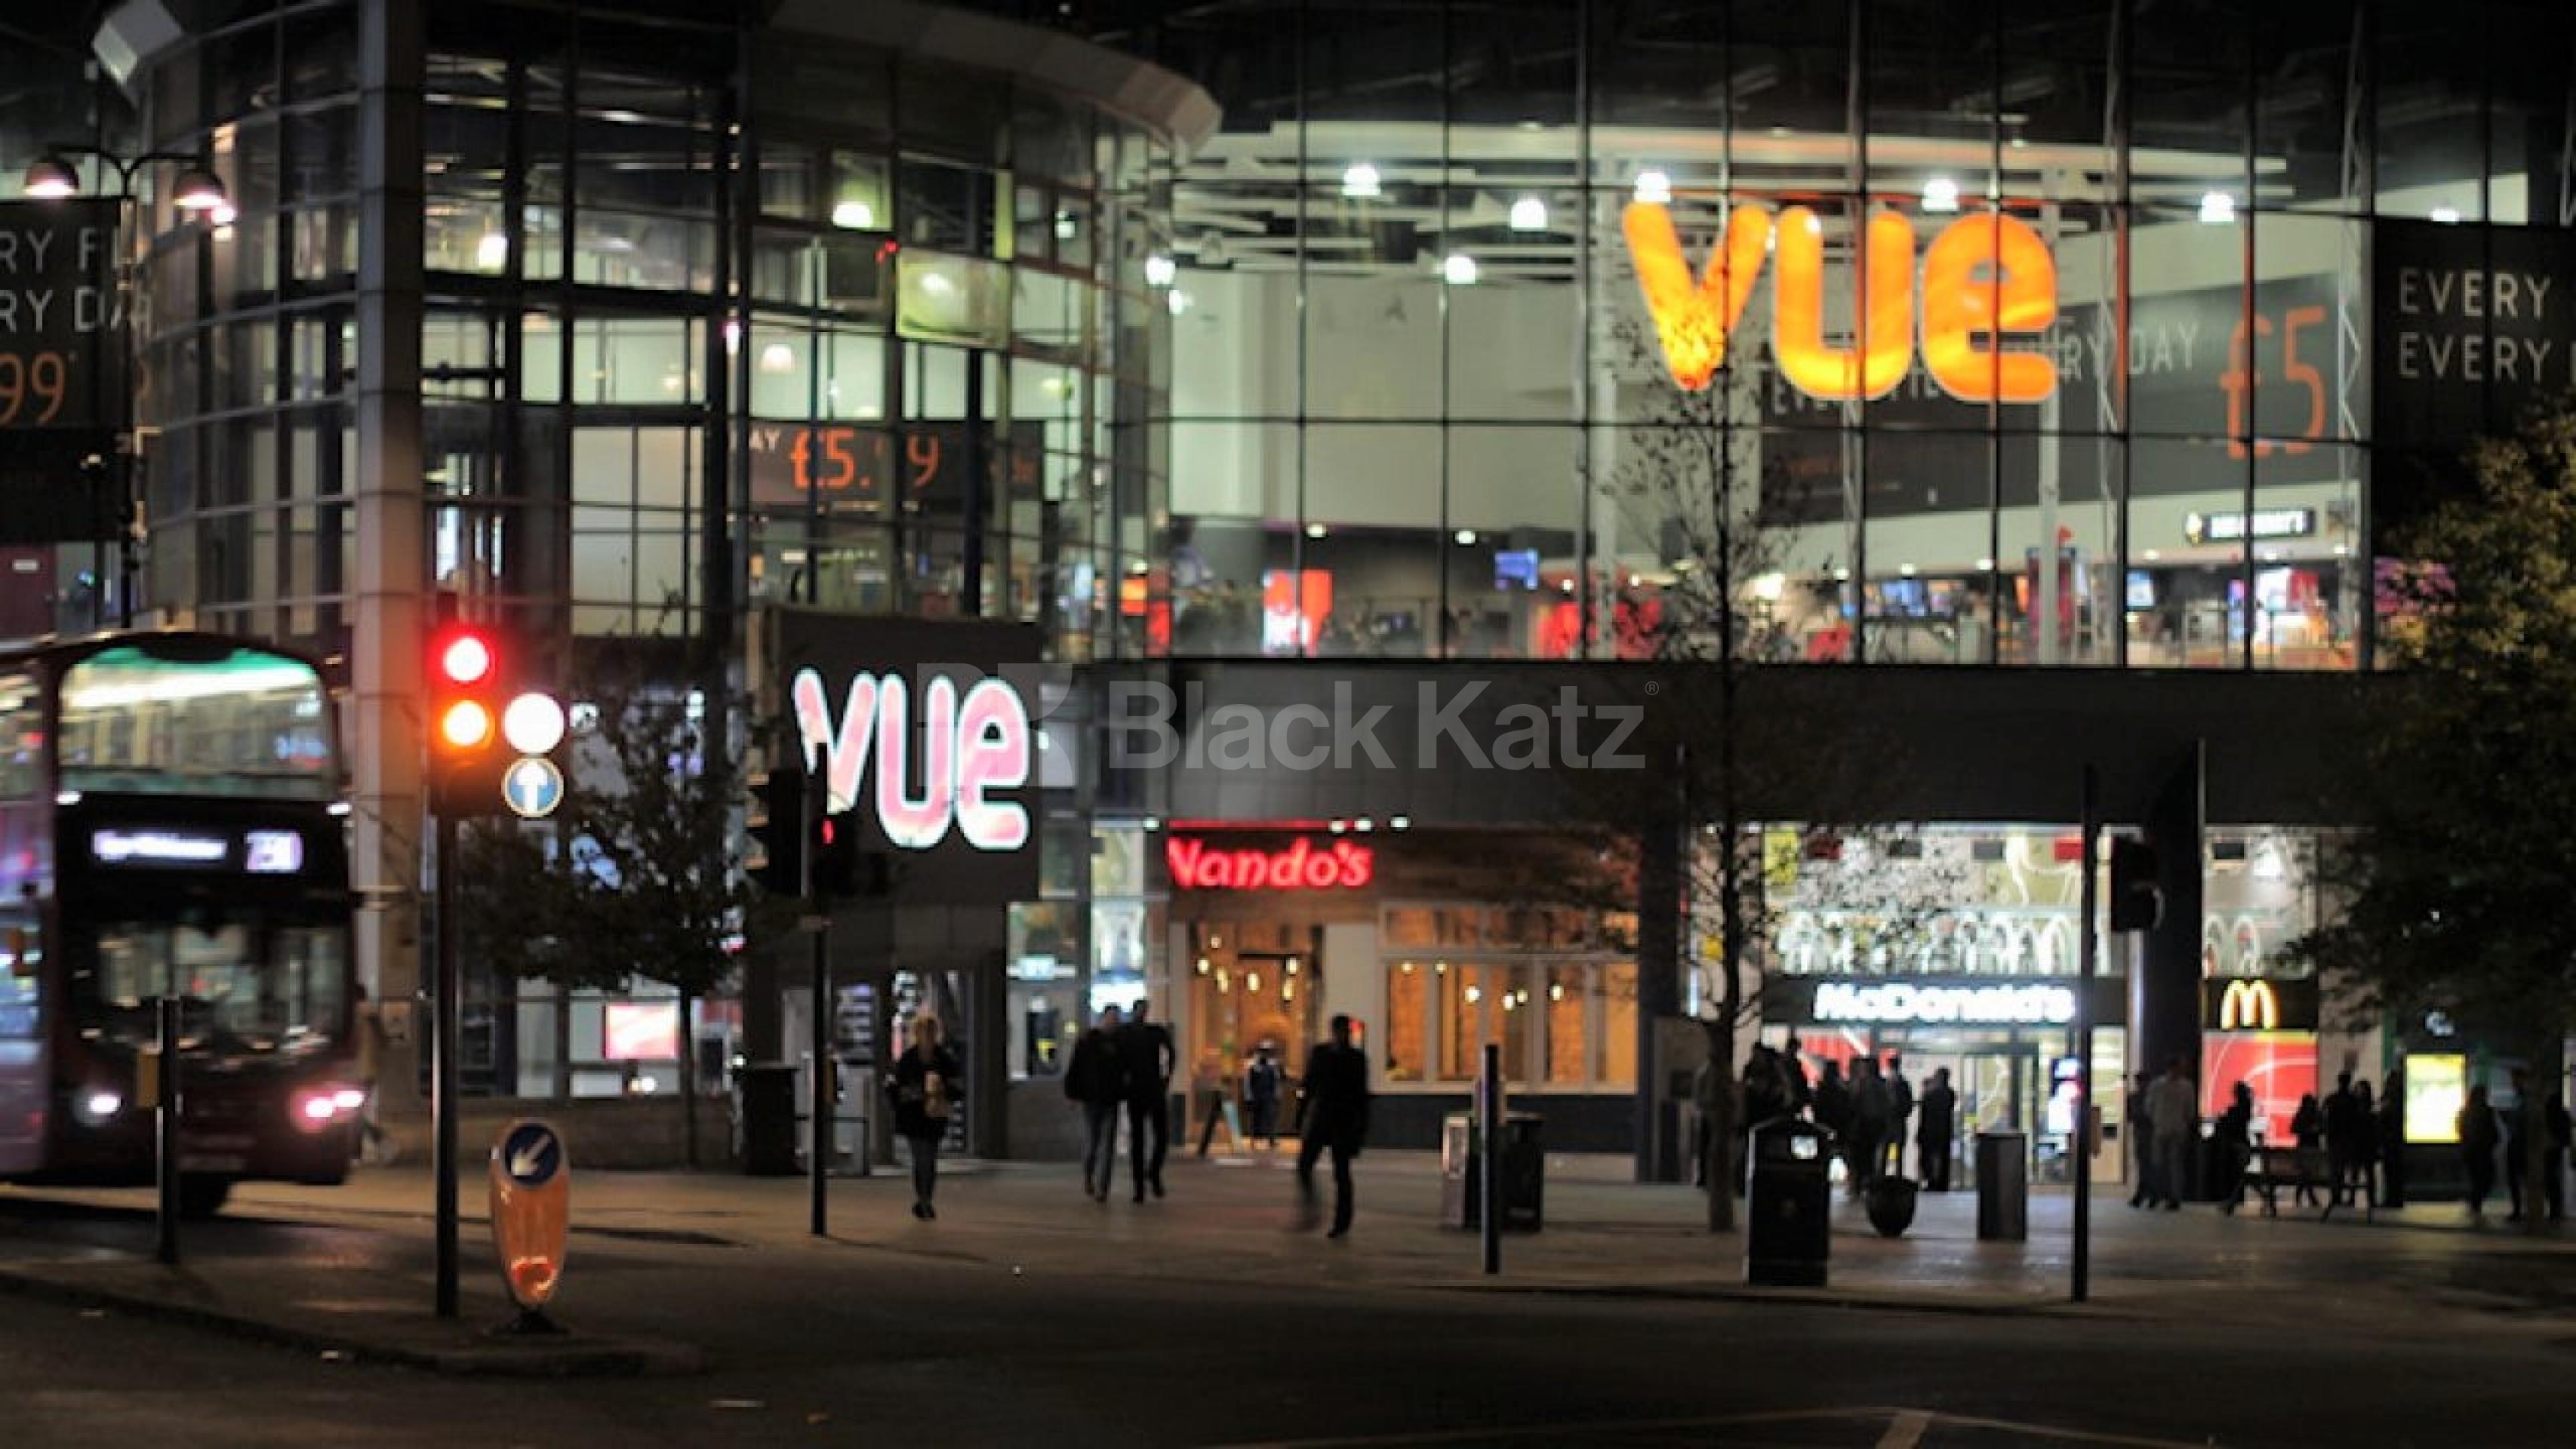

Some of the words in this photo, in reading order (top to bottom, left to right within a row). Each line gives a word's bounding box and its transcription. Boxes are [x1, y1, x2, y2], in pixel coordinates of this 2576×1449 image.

[1622, 201, 2058, 402] vue
[2399, 269, 2552, 321] EVERY
[2399, 331, 2552, 383] EVERY
[793, 665, 1029, 850] vue
[1167, 836, 1374, 890] Nando's
